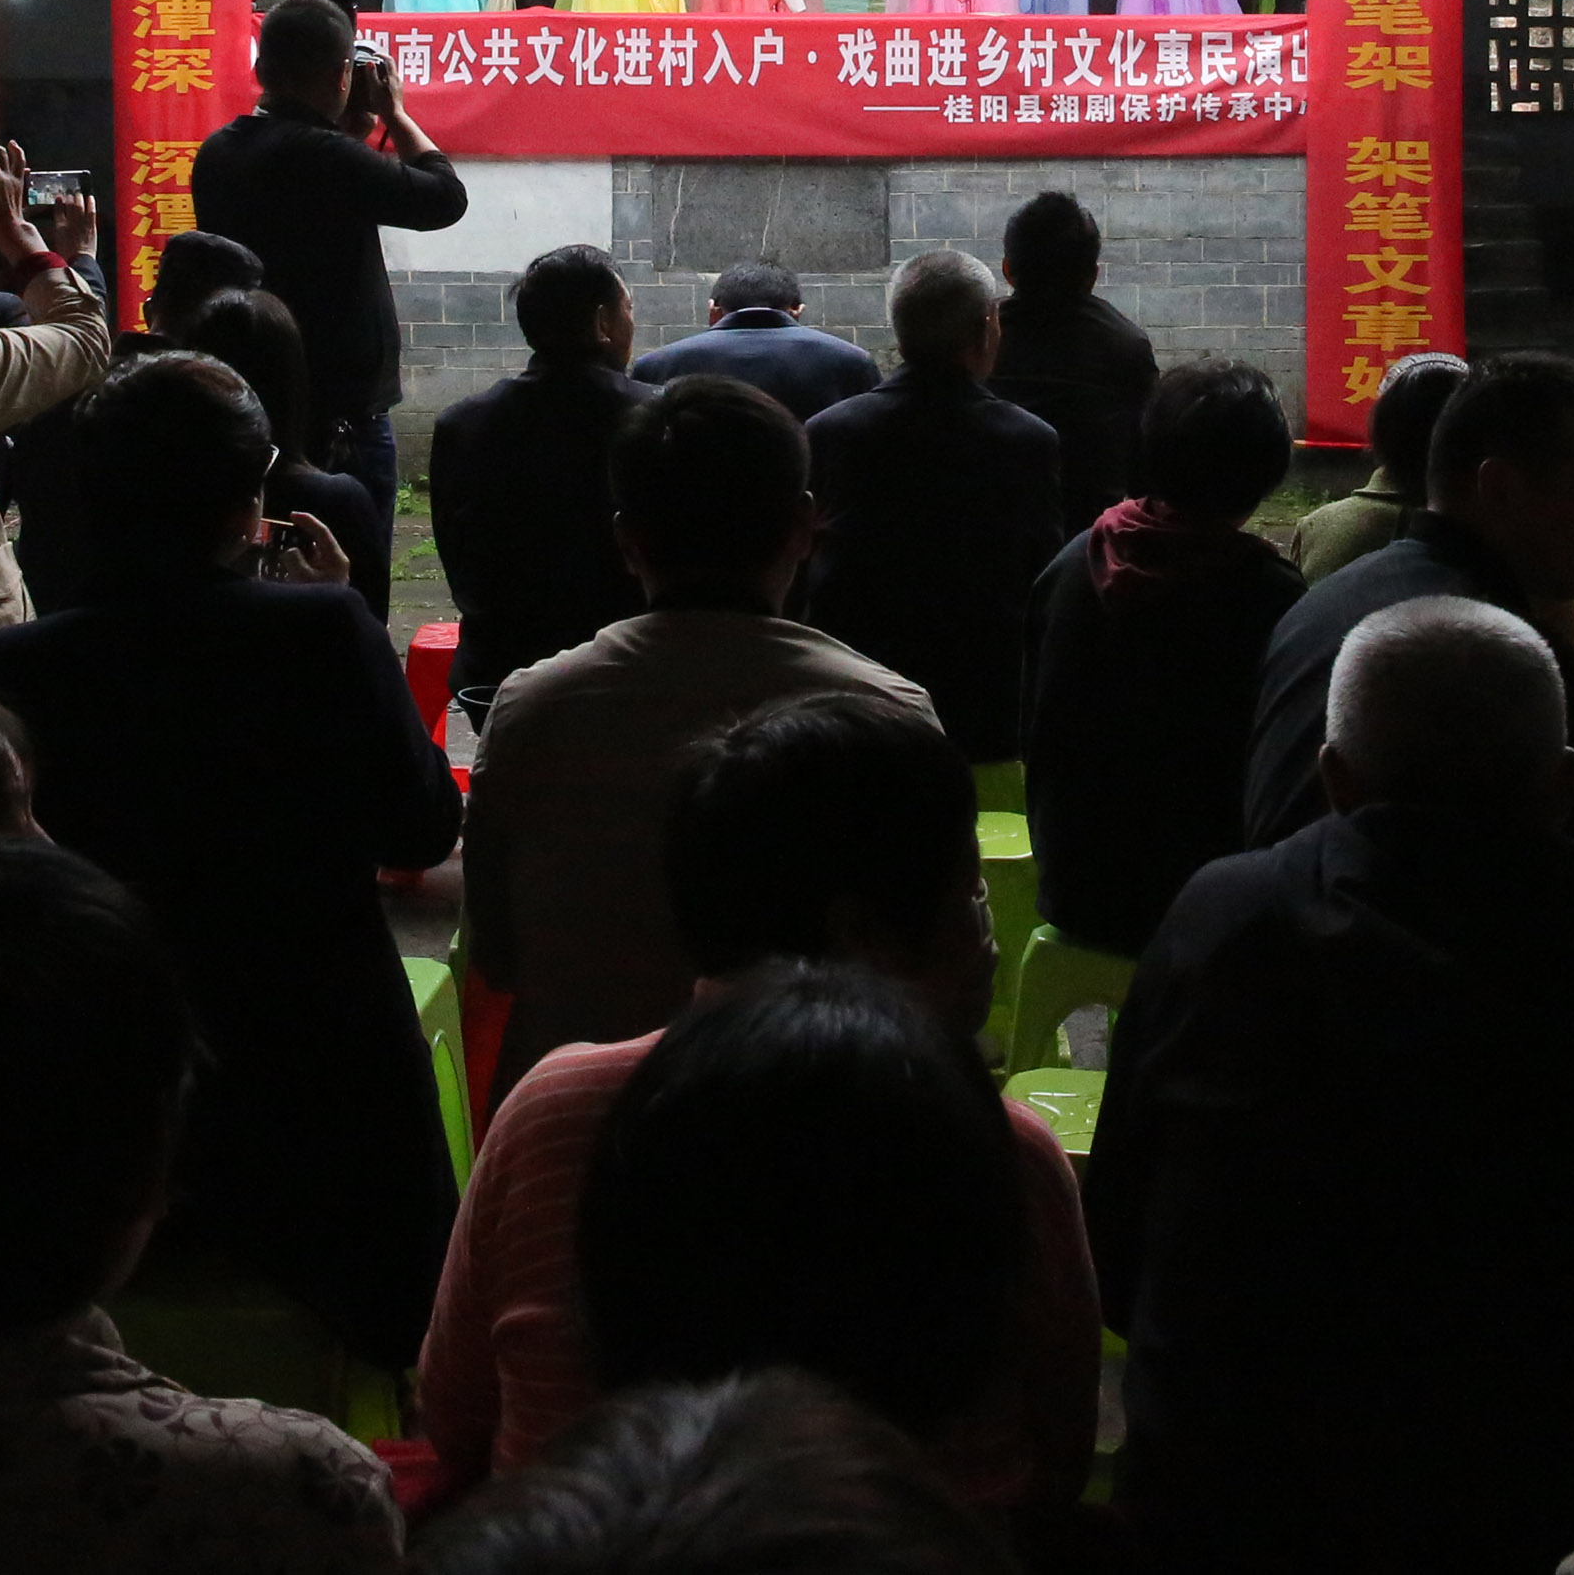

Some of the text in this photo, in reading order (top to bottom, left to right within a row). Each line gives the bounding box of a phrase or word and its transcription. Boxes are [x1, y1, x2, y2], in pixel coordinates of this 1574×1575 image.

[863, 92, 1307, 124] ——桂阳县湘剧保护传承中
[131, 140, 202, 333] 深潭
